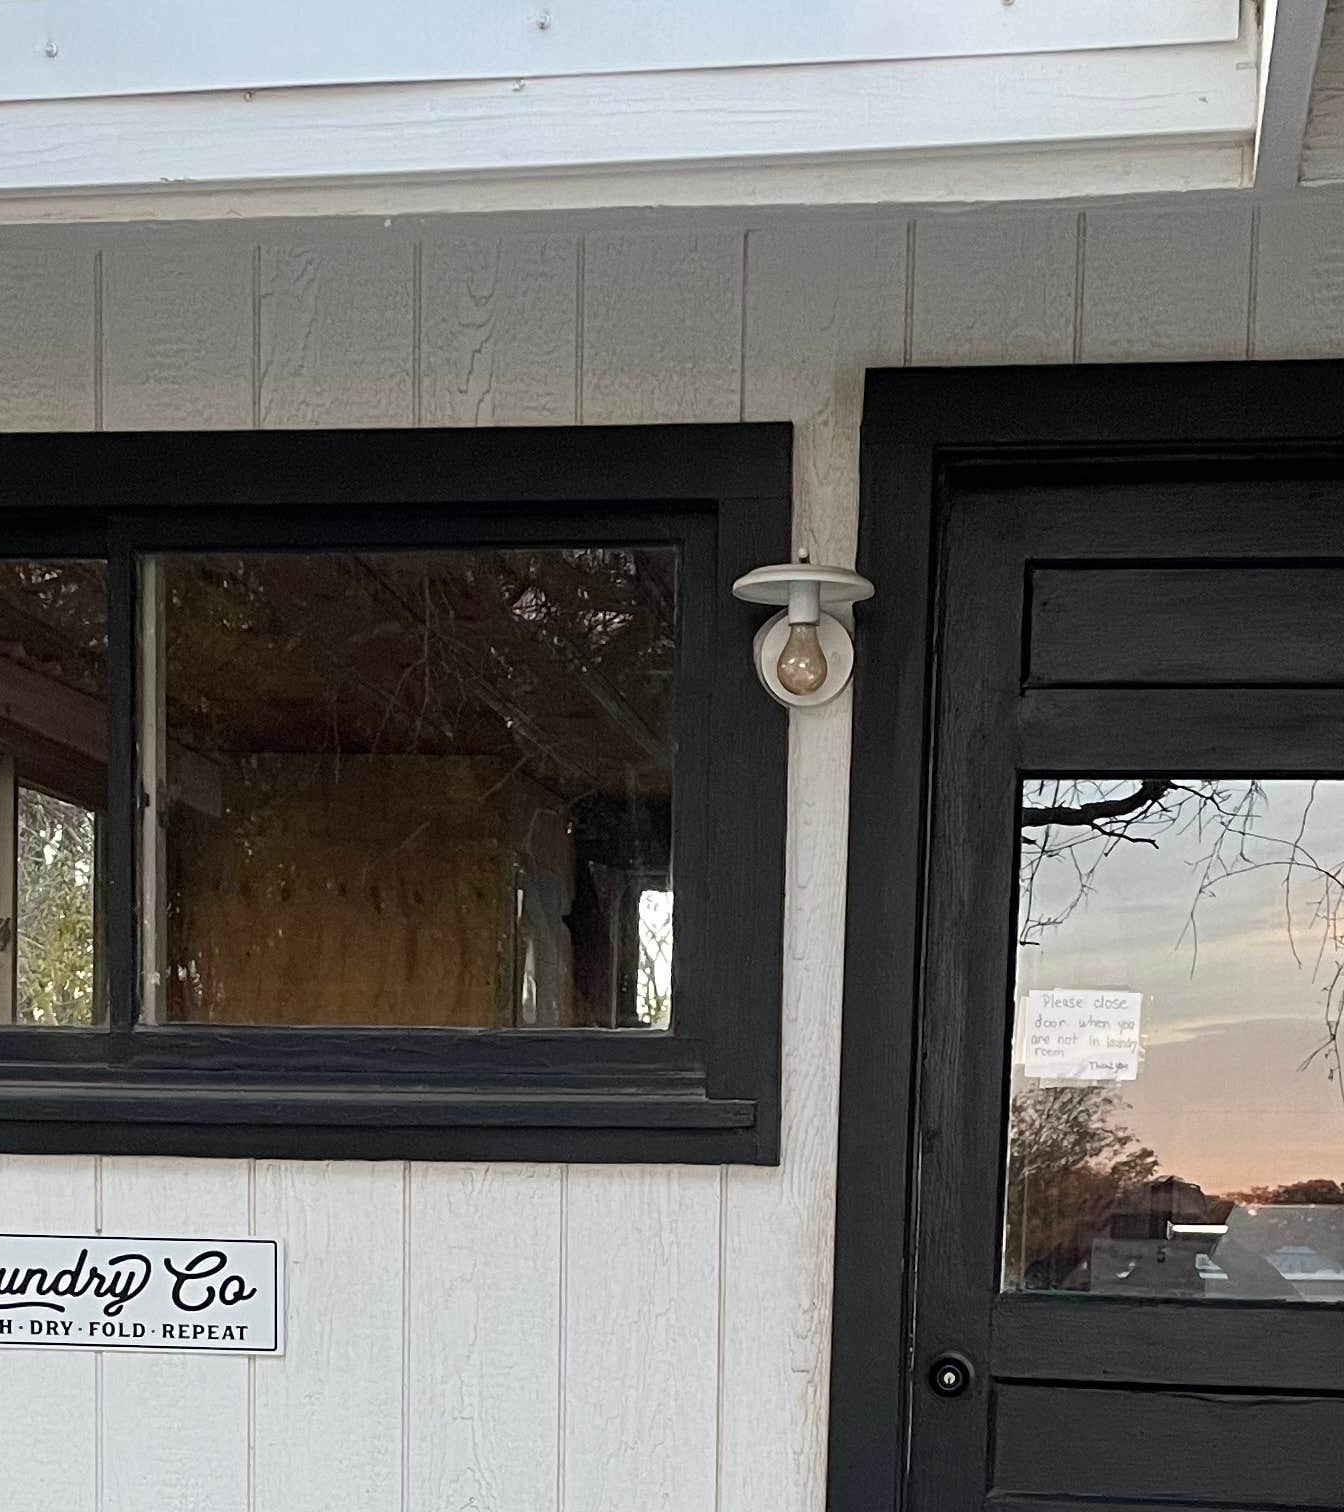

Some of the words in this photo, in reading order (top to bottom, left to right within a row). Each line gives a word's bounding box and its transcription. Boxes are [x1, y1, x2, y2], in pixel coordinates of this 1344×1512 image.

[1043, 994, 1083, 1009] Please
[1094, 995, 1128, 1009] close
[1034, 1015, 1067, 1028] door
[1079, 1016, 1110, 1028] when
[1118, 1019, 1135, 1034] you
[1031, 1033, 1049, 1045] are
[1057, 1034, 1078, 1046] not
[1089, 1036, 1100, 1047] in
[163, 1250, 258, 1312] Co
[30, 1320, 74, 1336] DRY
[88, 1321, 146, 1338] FOLD
[161, 1323, 249, 1341] REPEAT
